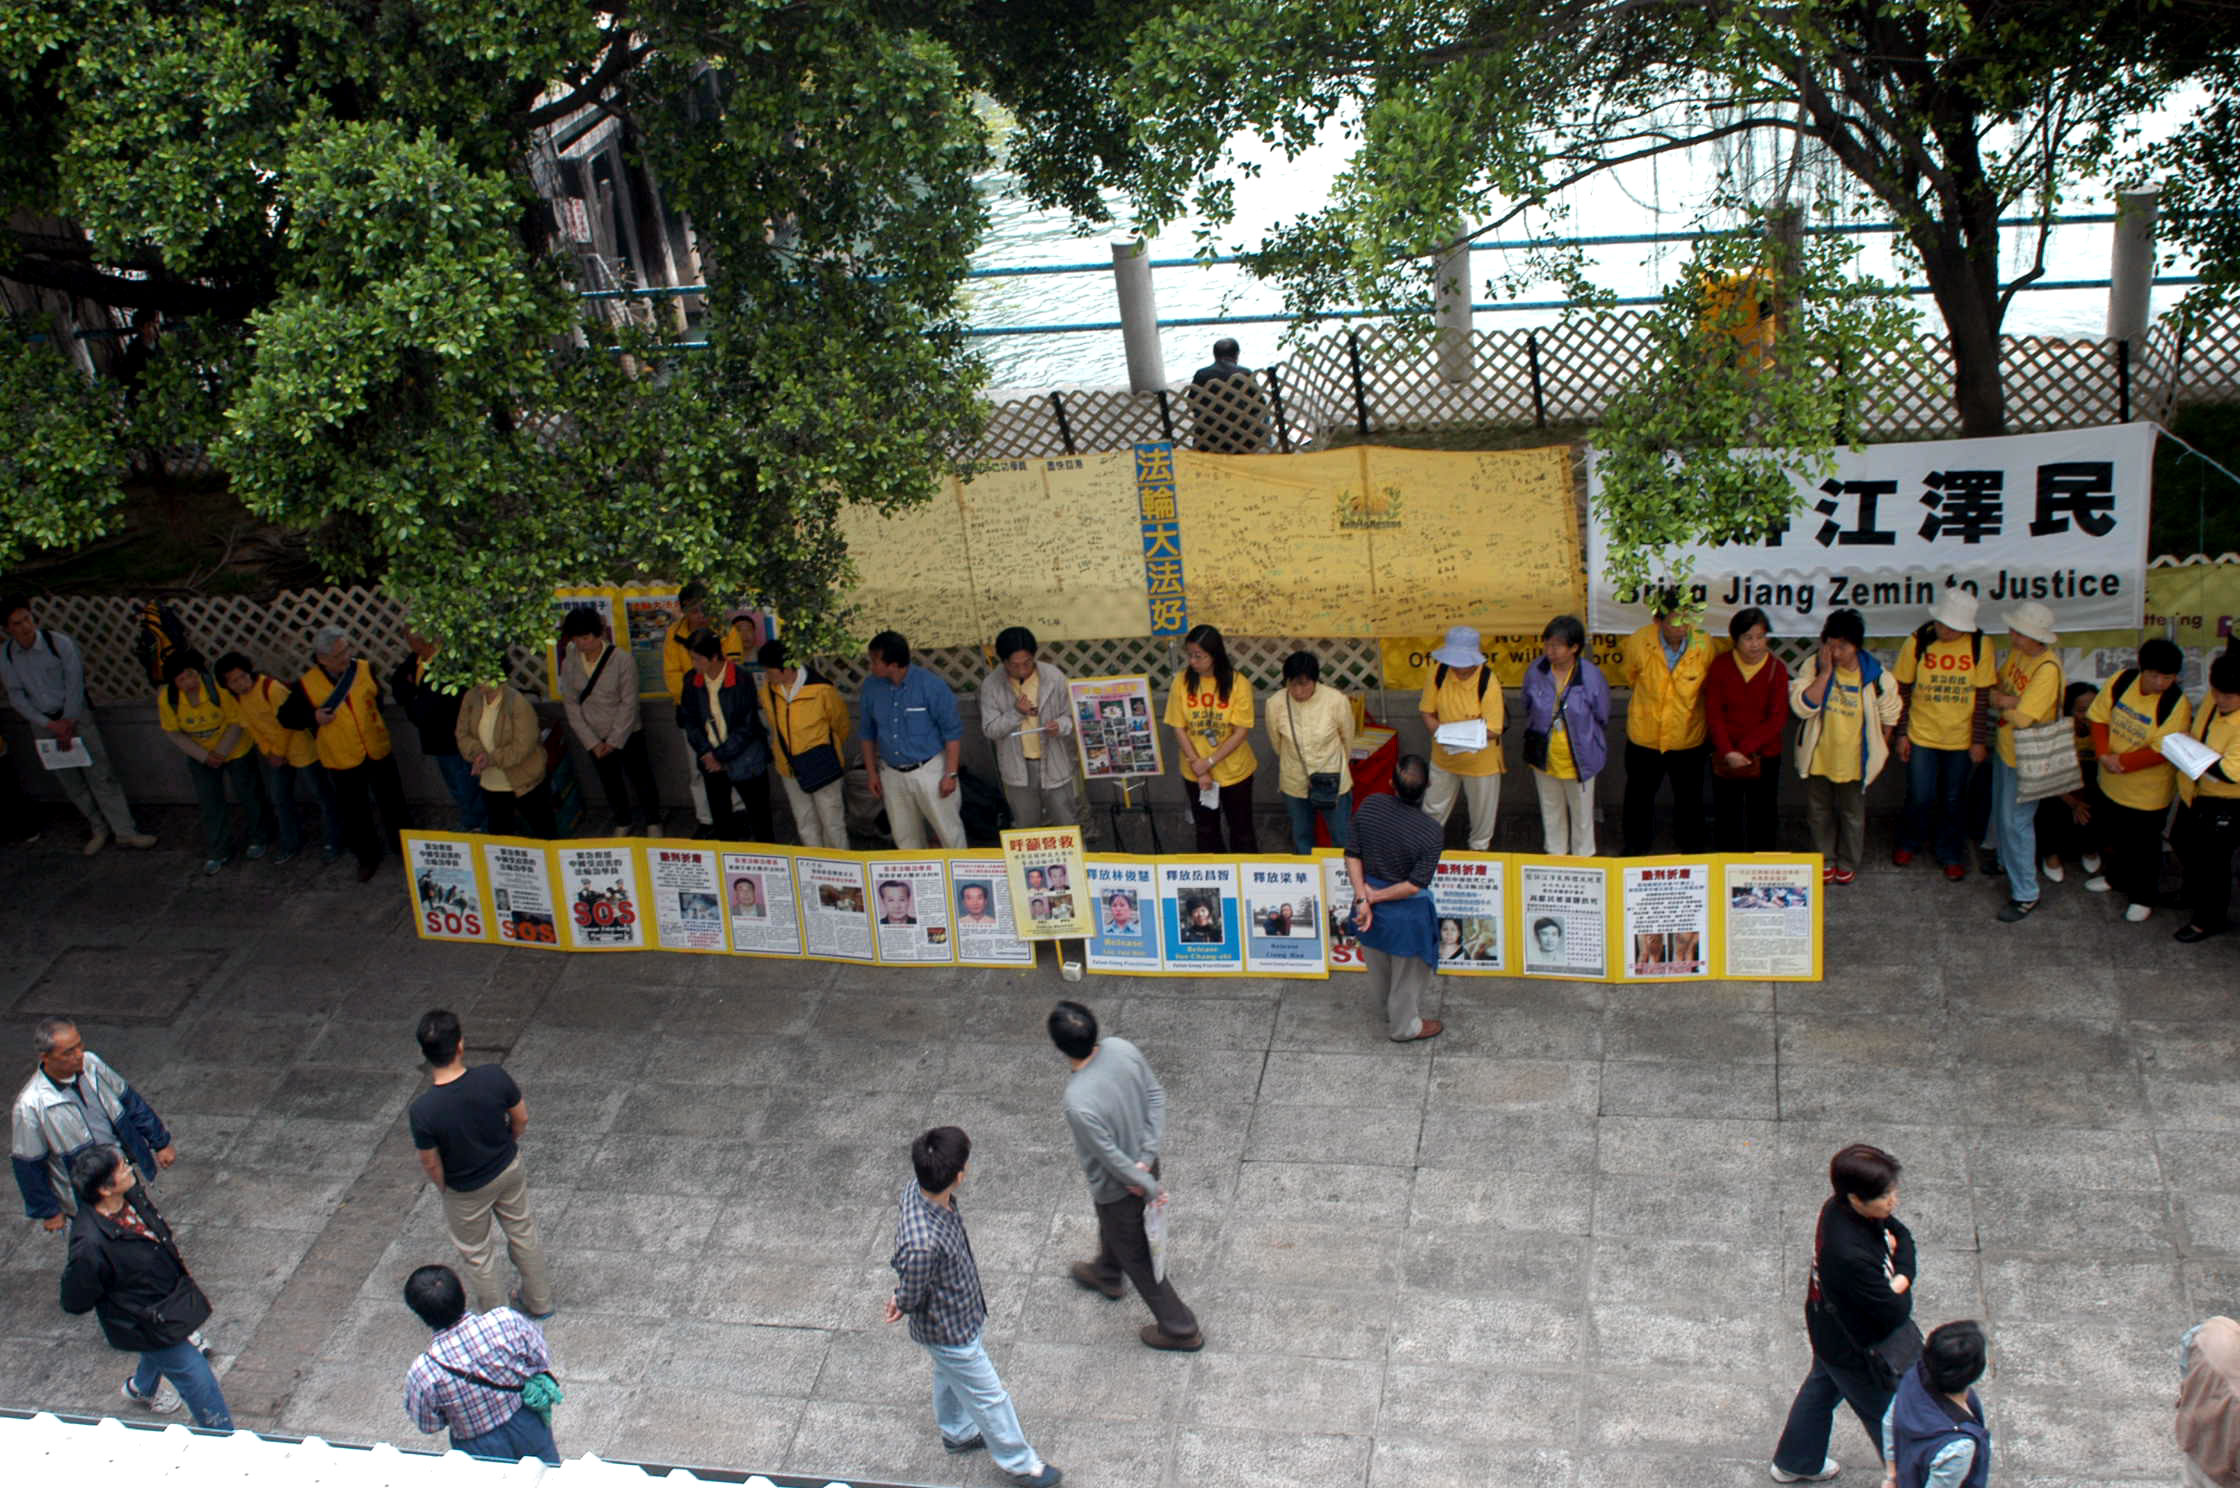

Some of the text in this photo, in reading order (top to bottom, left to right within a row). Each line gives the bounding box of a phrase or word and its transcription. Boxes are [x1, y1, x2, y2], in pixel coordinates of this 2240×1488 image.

[1137, 447, 1185, 631] 法輪大法好
[1723, 576, 1814, 614] Jiang
[1829, 575, 1933, 606] Zemin
[1989, 570, 2121, 600] Justice
[1924, 653, 1971, 671] SOS
[1187, 693, 1229, 708] SOS
[1642, 869, 1691, 881] 酷刑折磨
[427, 911, 480, 935] SOS
[574, 900, 636, 926] SOS
[502, 919, 556, 944] SOS
